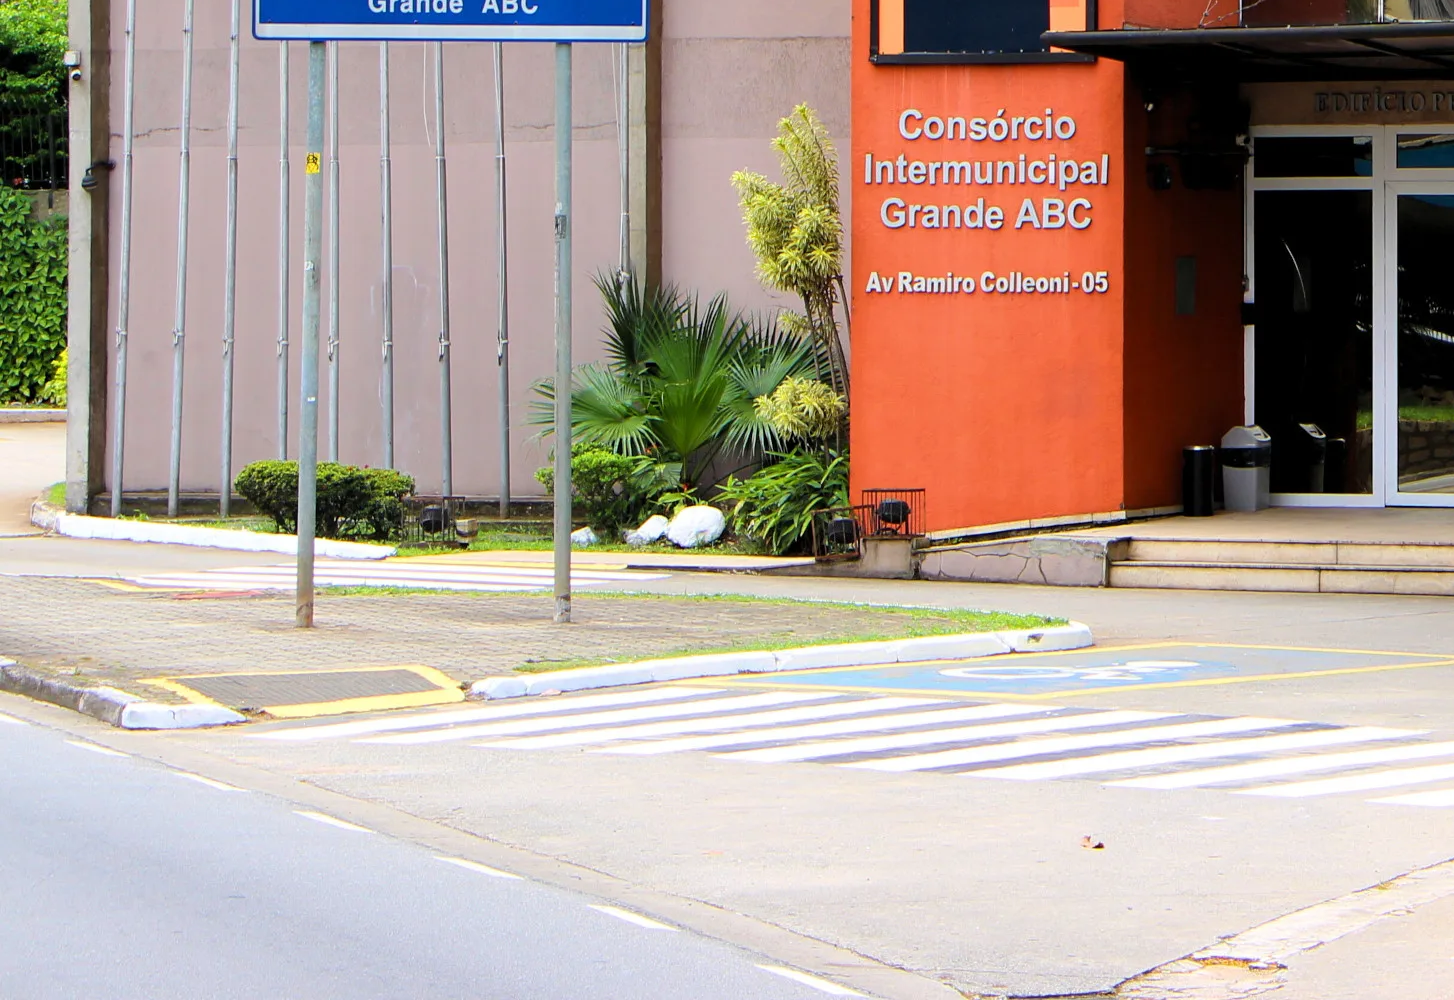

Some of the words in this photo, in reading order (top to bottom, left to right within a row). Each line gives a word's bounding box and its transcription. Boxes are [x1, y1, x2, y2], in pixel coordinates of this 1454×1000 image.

[898, 108, 1076, 141] Consórcio
[864, 153, 1110, 191] Intermunicipal
[880, 197, 1004, 230] Grande
[1014, 198, 1092, 229] ABC
[865, 271, 894, 293] Av
[898, 271, 976, 293] Ramiro
[980, 271, 1069, 293] Colleoni
[1081, 271, 1108, 293] 05
